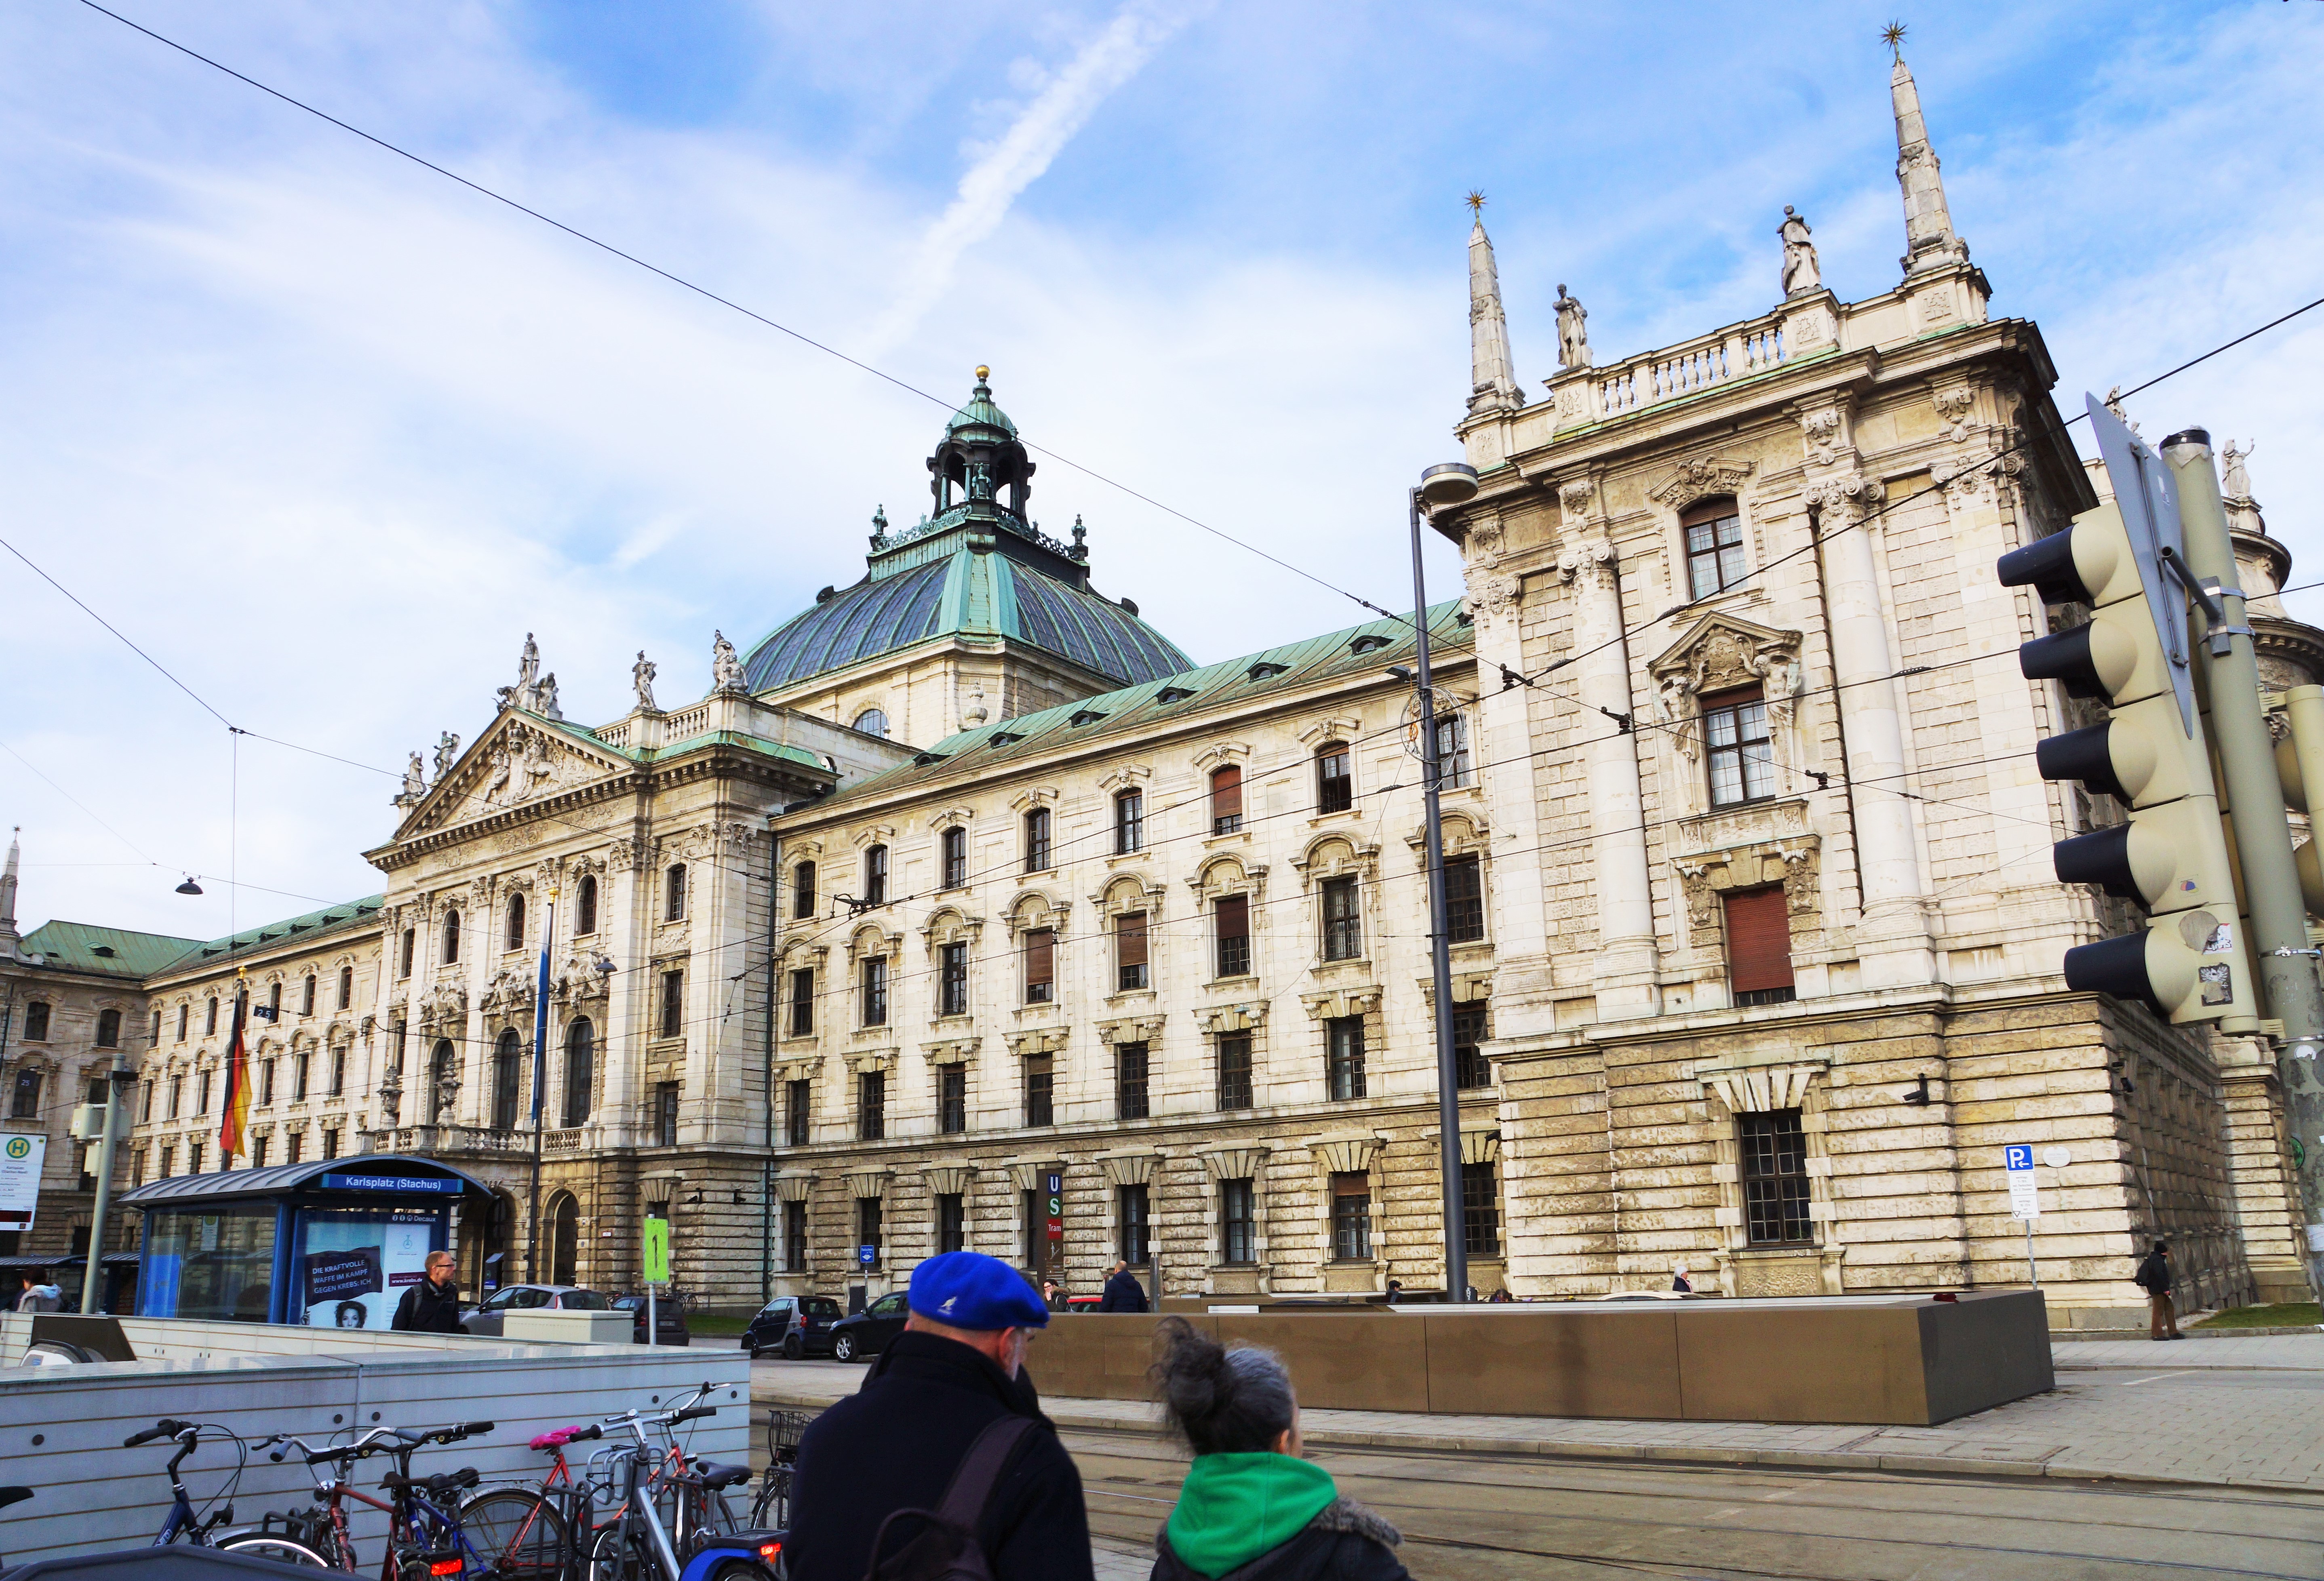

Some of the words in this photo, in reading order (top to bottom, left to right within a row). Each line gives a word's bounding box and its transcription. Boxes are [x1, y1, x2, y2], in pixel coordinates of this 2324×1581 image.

[258, 1009, 271, 1018] 25
[12, 1142, 24, 1154] H
[2009, 1148, 2025, 1168] P
[346, 1176, 394, 1189] Karlsplatz
[397, 1179, 441, 1191] (Stachus)
[1050, 1176, 1059, 1192] U
[1050, 1198, 1060, 1215] S
[652, 1234, 657, 1269] 1
[324, 1260, 365, 1272] KRAFTVOLLE
[313, 1275, 335, 1284] WAFFE
[346, 1269, 368, 1278] KAMPF
[314, 1285, 337, 1293] GEGEN
[338, 1280, 360, 1290] KREBS:
